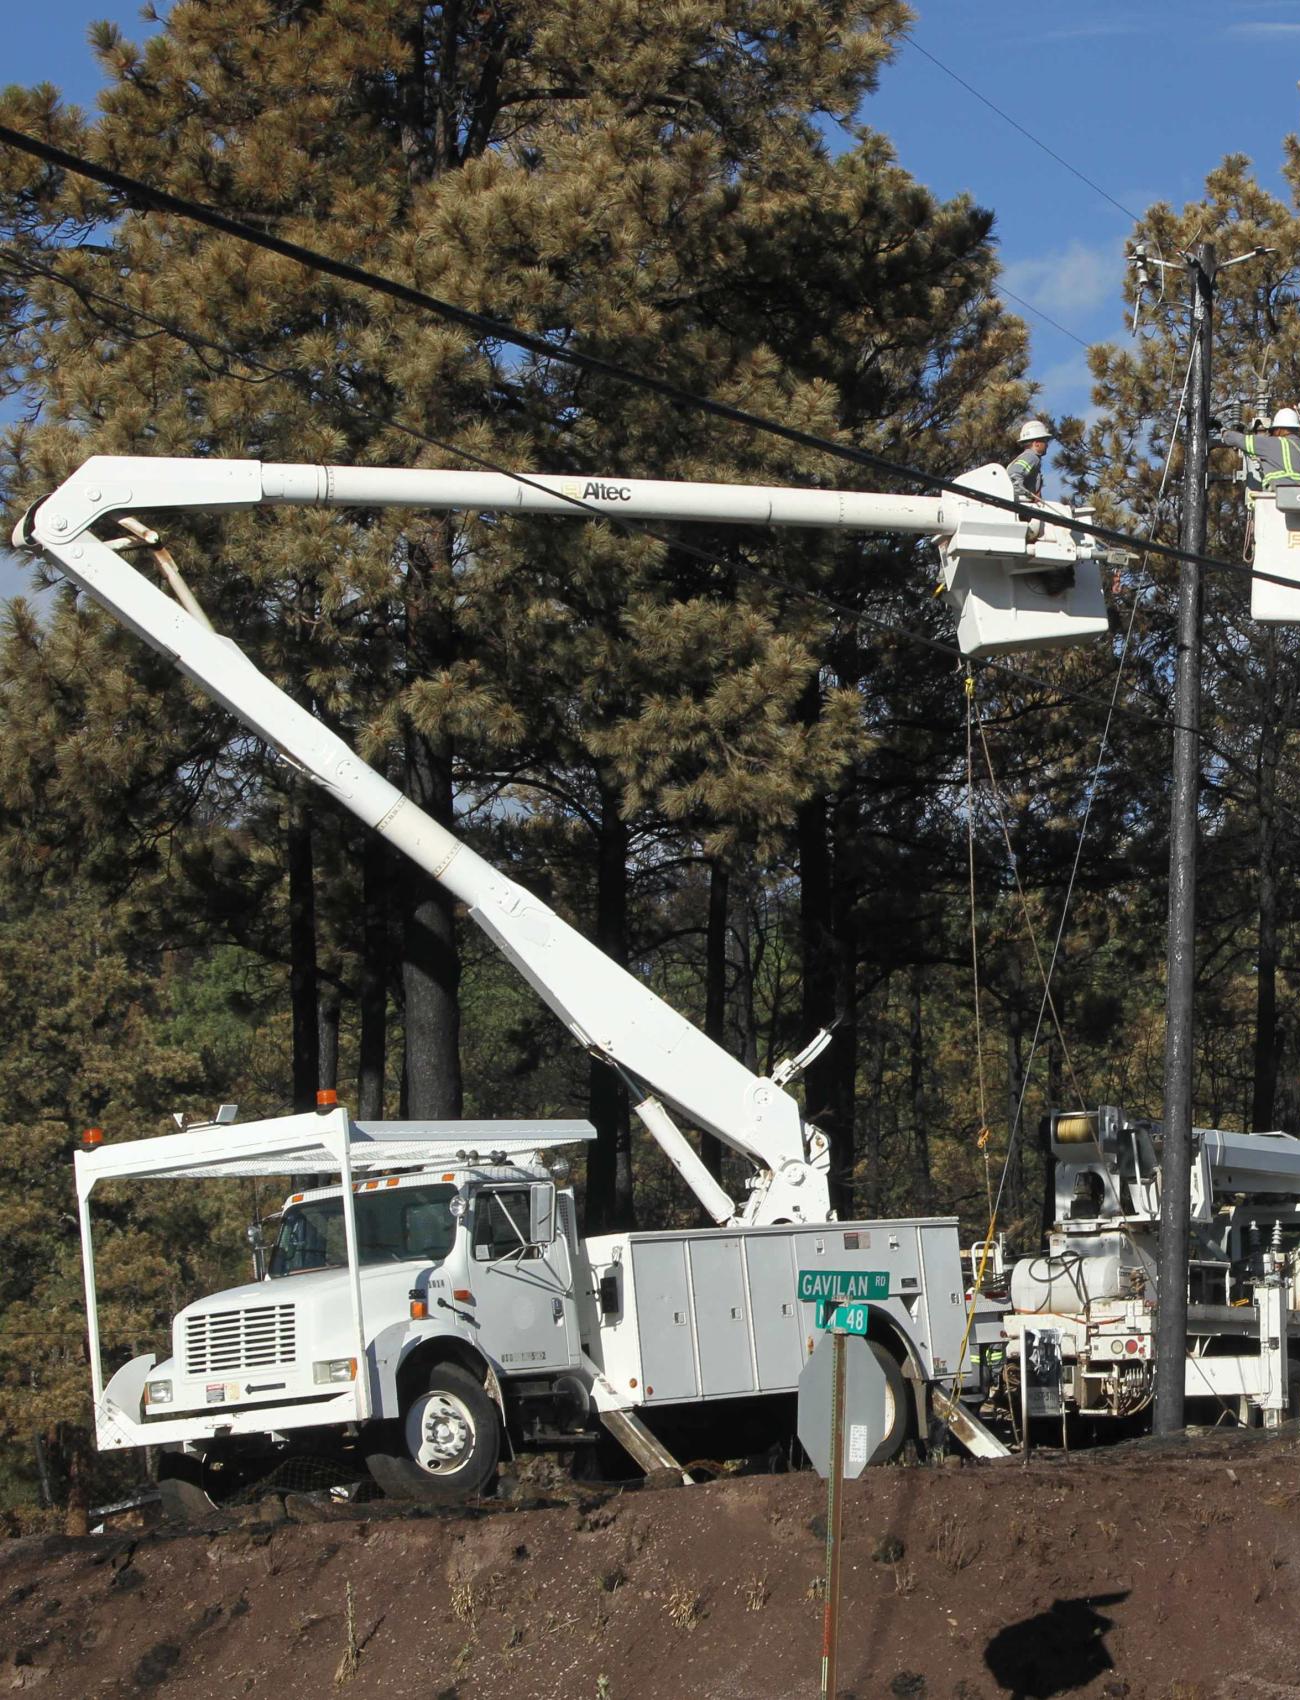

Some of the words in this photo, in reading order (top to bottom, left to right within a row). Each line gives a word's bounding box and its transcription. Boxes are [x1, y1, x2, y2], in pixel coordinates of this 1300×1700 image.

[583, 482, 632, 501] Altec
[802, 1274, 868, 1296] GAVILAN
[875, 1276, 887, 1287] RD
[846, 1308, 864, 1331] 48
